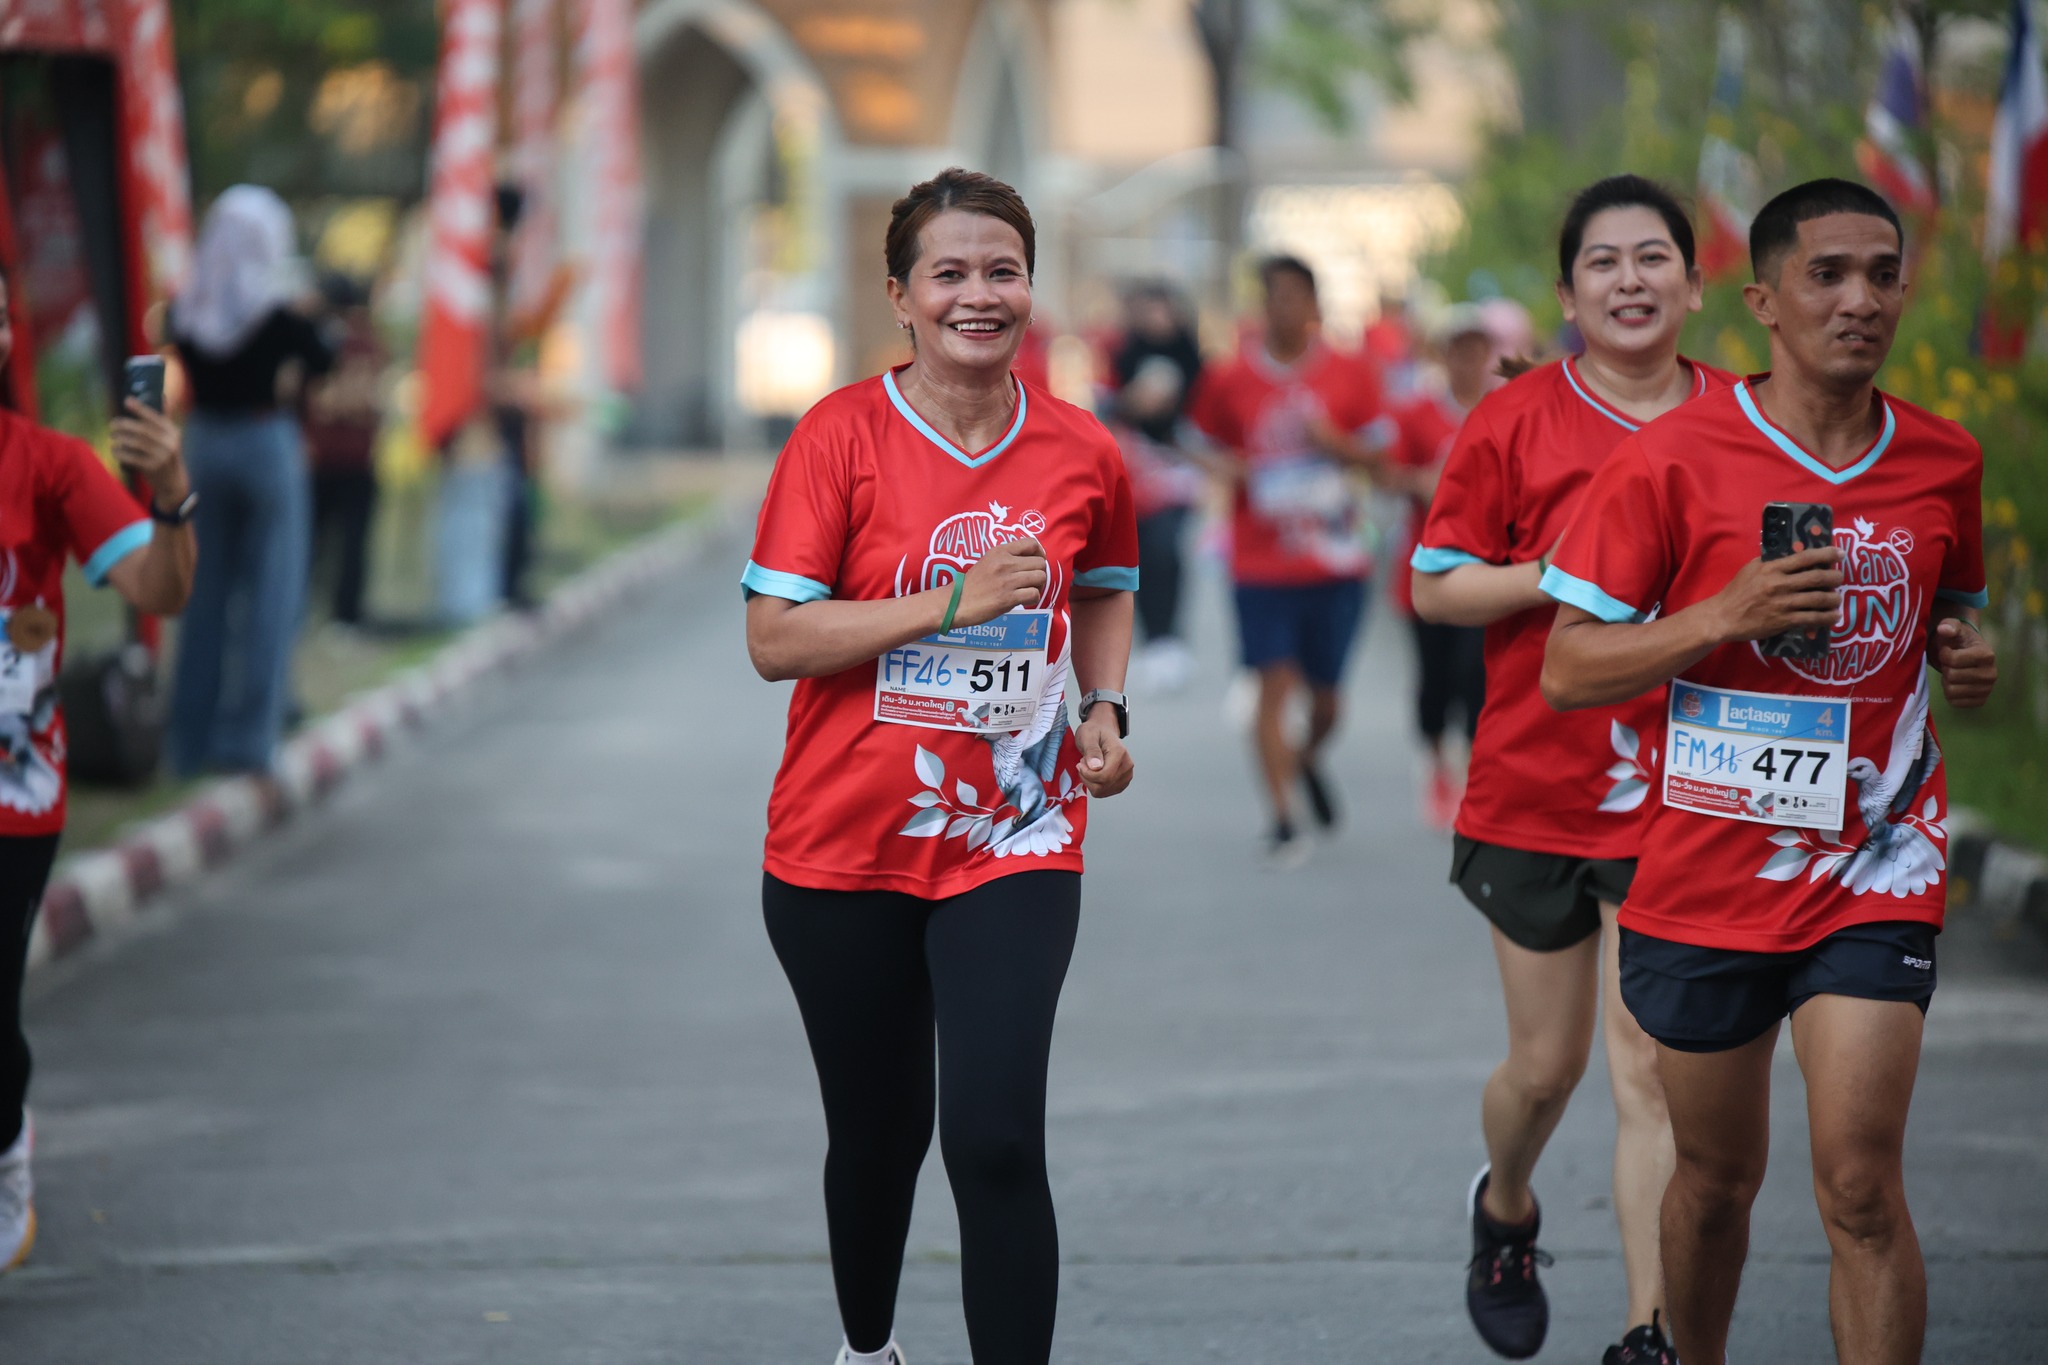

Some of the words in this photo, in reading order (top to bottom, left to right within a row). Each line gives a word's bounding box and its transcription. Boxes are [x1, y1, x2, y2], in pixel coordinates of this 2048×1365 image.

[937, 517, 991, 558] WALK
[1860, 550, 1901, 584] and
[1026, 618, 1039, 636] 4
[1830, 590, 1901, 638] UN
[1024, 638, 1039, 646] km.
[969, 659, 1030, 692] 511
[1717, 695, 1792, 729] Lactasoy
[1817, 707, 1833, 727] 4
[1752, 747, 1831, 785] 477
